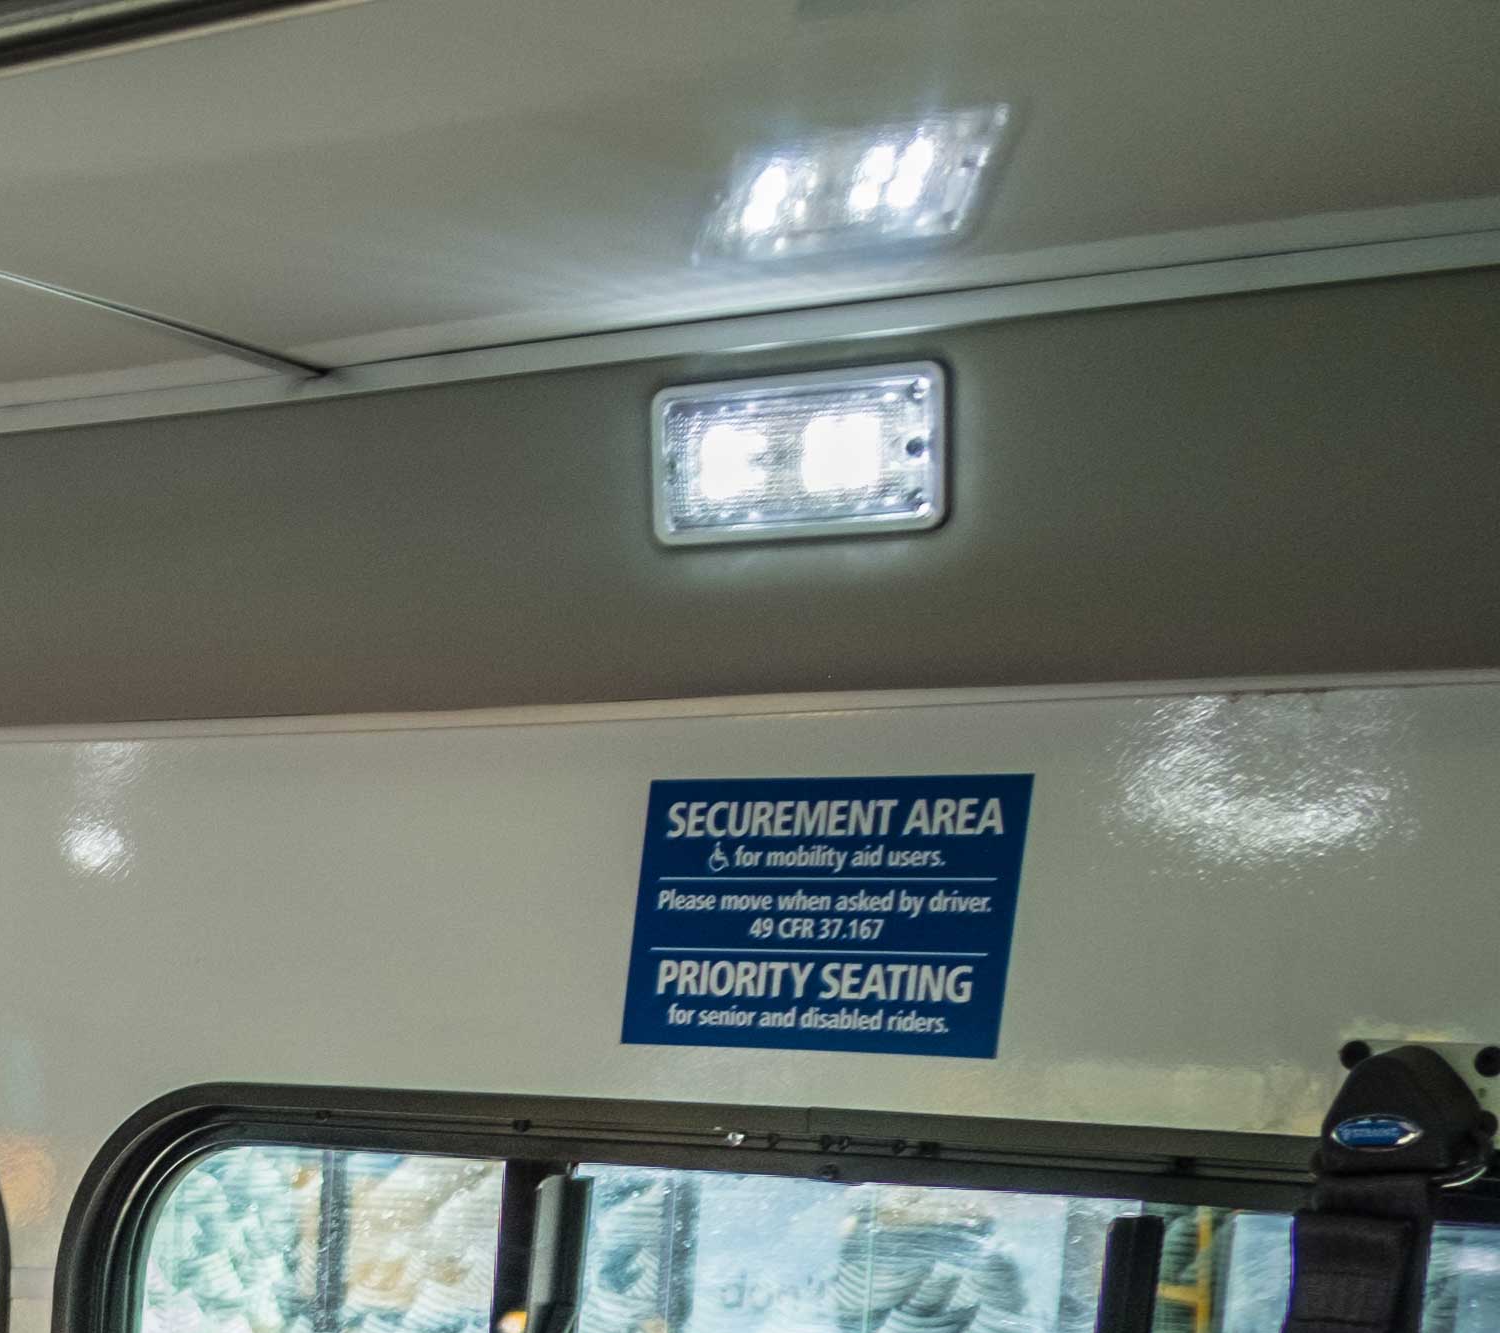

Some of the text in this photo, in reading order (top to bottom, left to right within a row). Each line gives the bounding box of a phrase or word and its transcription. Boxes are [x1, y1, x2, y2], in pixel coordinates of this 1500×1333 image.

[666, 798, 1004, 838] SECUREMENT AREA
[735, 844, 947, 873] for mobility aid users.
[657, 889, 993, 917] Please move when asked by driver.
[750, 918, 884, 940] 49 CFR 37.167
[656, 959, 974, 1003] PRIORITY SEATING
[667, 1005, 949, 1034] for senior and disabled riders.
